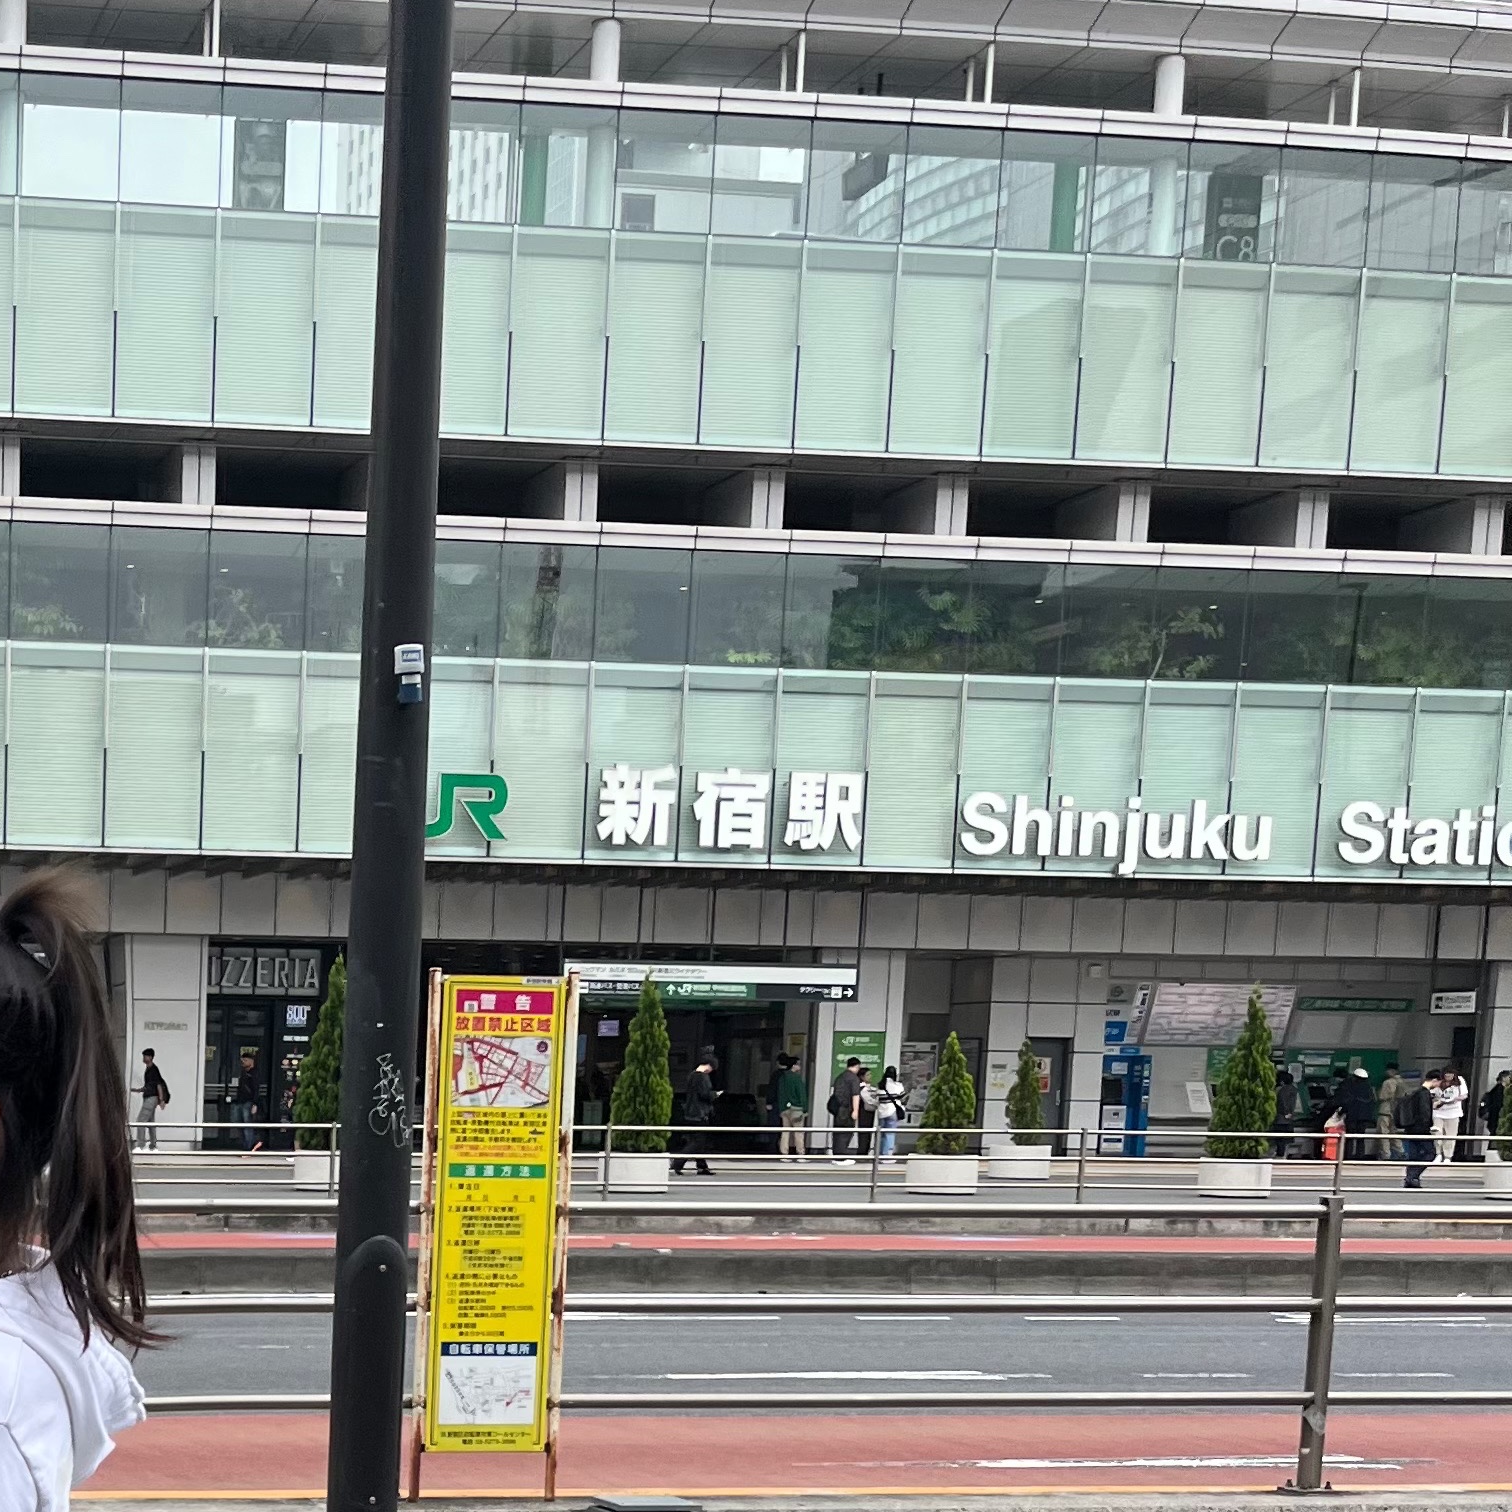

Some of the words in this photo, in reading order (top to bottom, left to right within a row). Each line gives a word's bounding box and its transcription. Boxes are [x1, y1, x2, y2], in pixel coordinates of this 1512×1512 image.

[425, 772, 509, 842] JR
[596, 763, 864, 851] 新宿駅
[959, 791, 1273, 876] Shinjuku
[454, 1014, 552, 1033] 放置禁止区域
